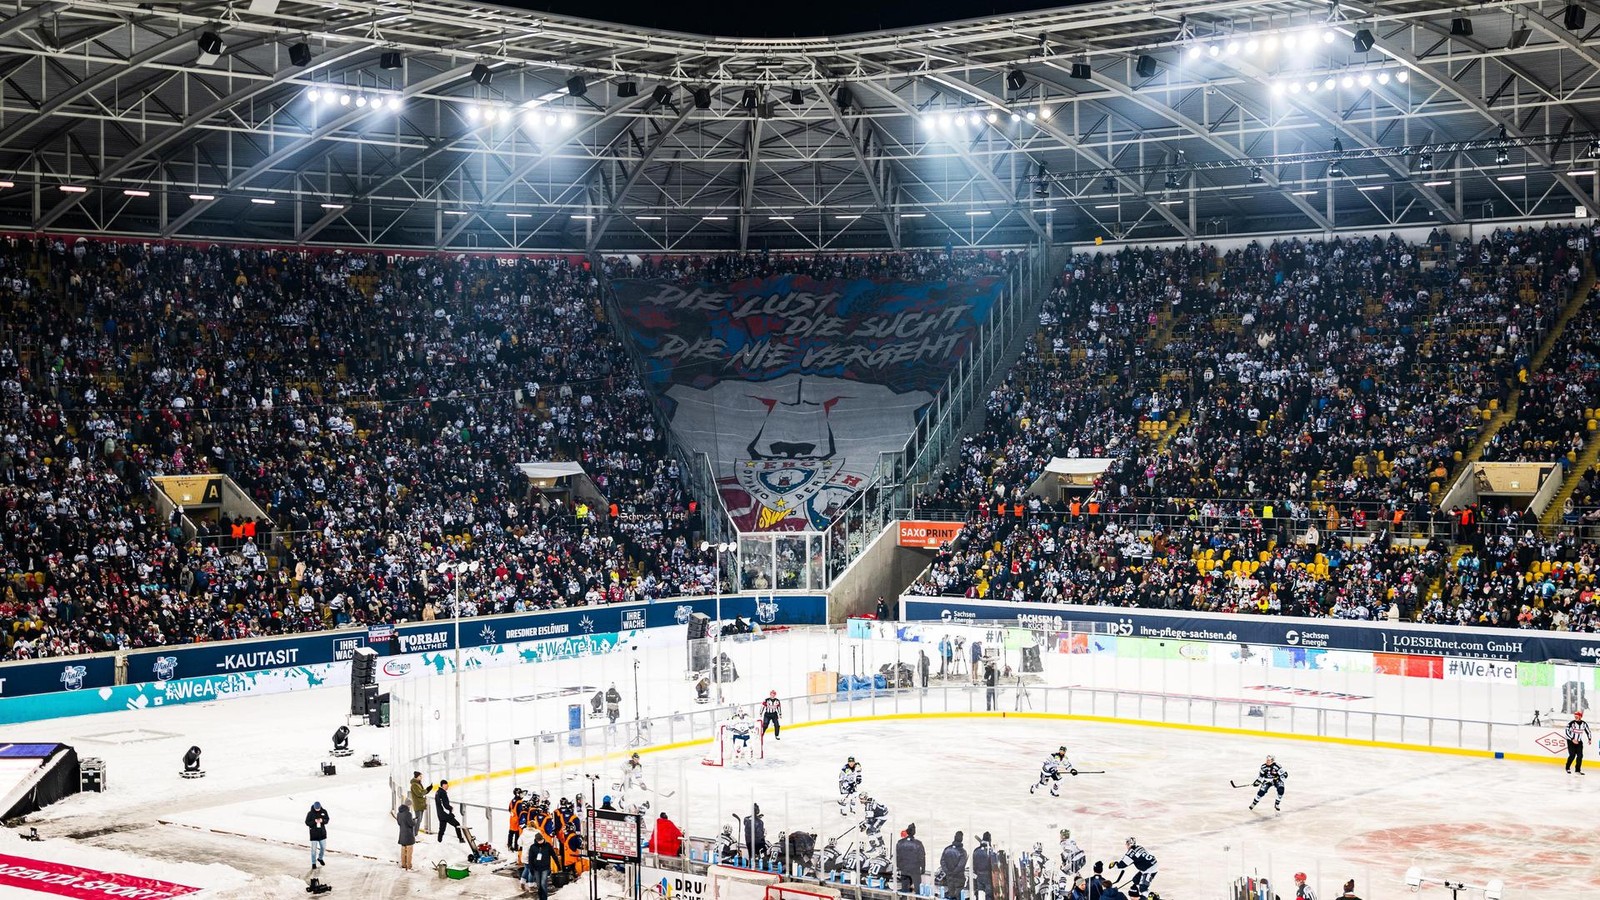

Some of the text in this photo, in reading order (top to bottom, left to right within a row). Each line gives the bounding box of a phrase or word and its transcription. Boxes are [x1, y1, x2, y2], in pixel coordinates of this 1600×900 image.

[646, 283, 843, 320] DIE LUST
[774, 305, 974, 339] DIE SUCHT
[648, 331, 967, 373] DIE NIE VERGEHT
[209, 485, 218, 498] A
[901, 528, 954, 538] SAXOPRINT
[625, 611, 641, 620] IHRE
[953, 610, 976, 618] Sachsen
[1017, 613, 1053, 623] SACHSEN
[622, 619, 645, 630] WACHE
[506, 622, 569, 639] DRESDNER EISLÖWEN
[1140, 626, 1237, 641] ihre-pflege-sachsen.de
[1301, 631, 1330, 640] Sachsen
[340, 639, 358, 650] IHRE
[398, 631, 448, 653] TORBAU
[410, 642, 448, 652] WALTHER
[1301, 638, 1328, 648] Energie
[1393, 635, 1523, 653] LOESERnet.com GmbH
[335, 650, 355, 661] WAC
[675, 878, 707, 895] DRU
